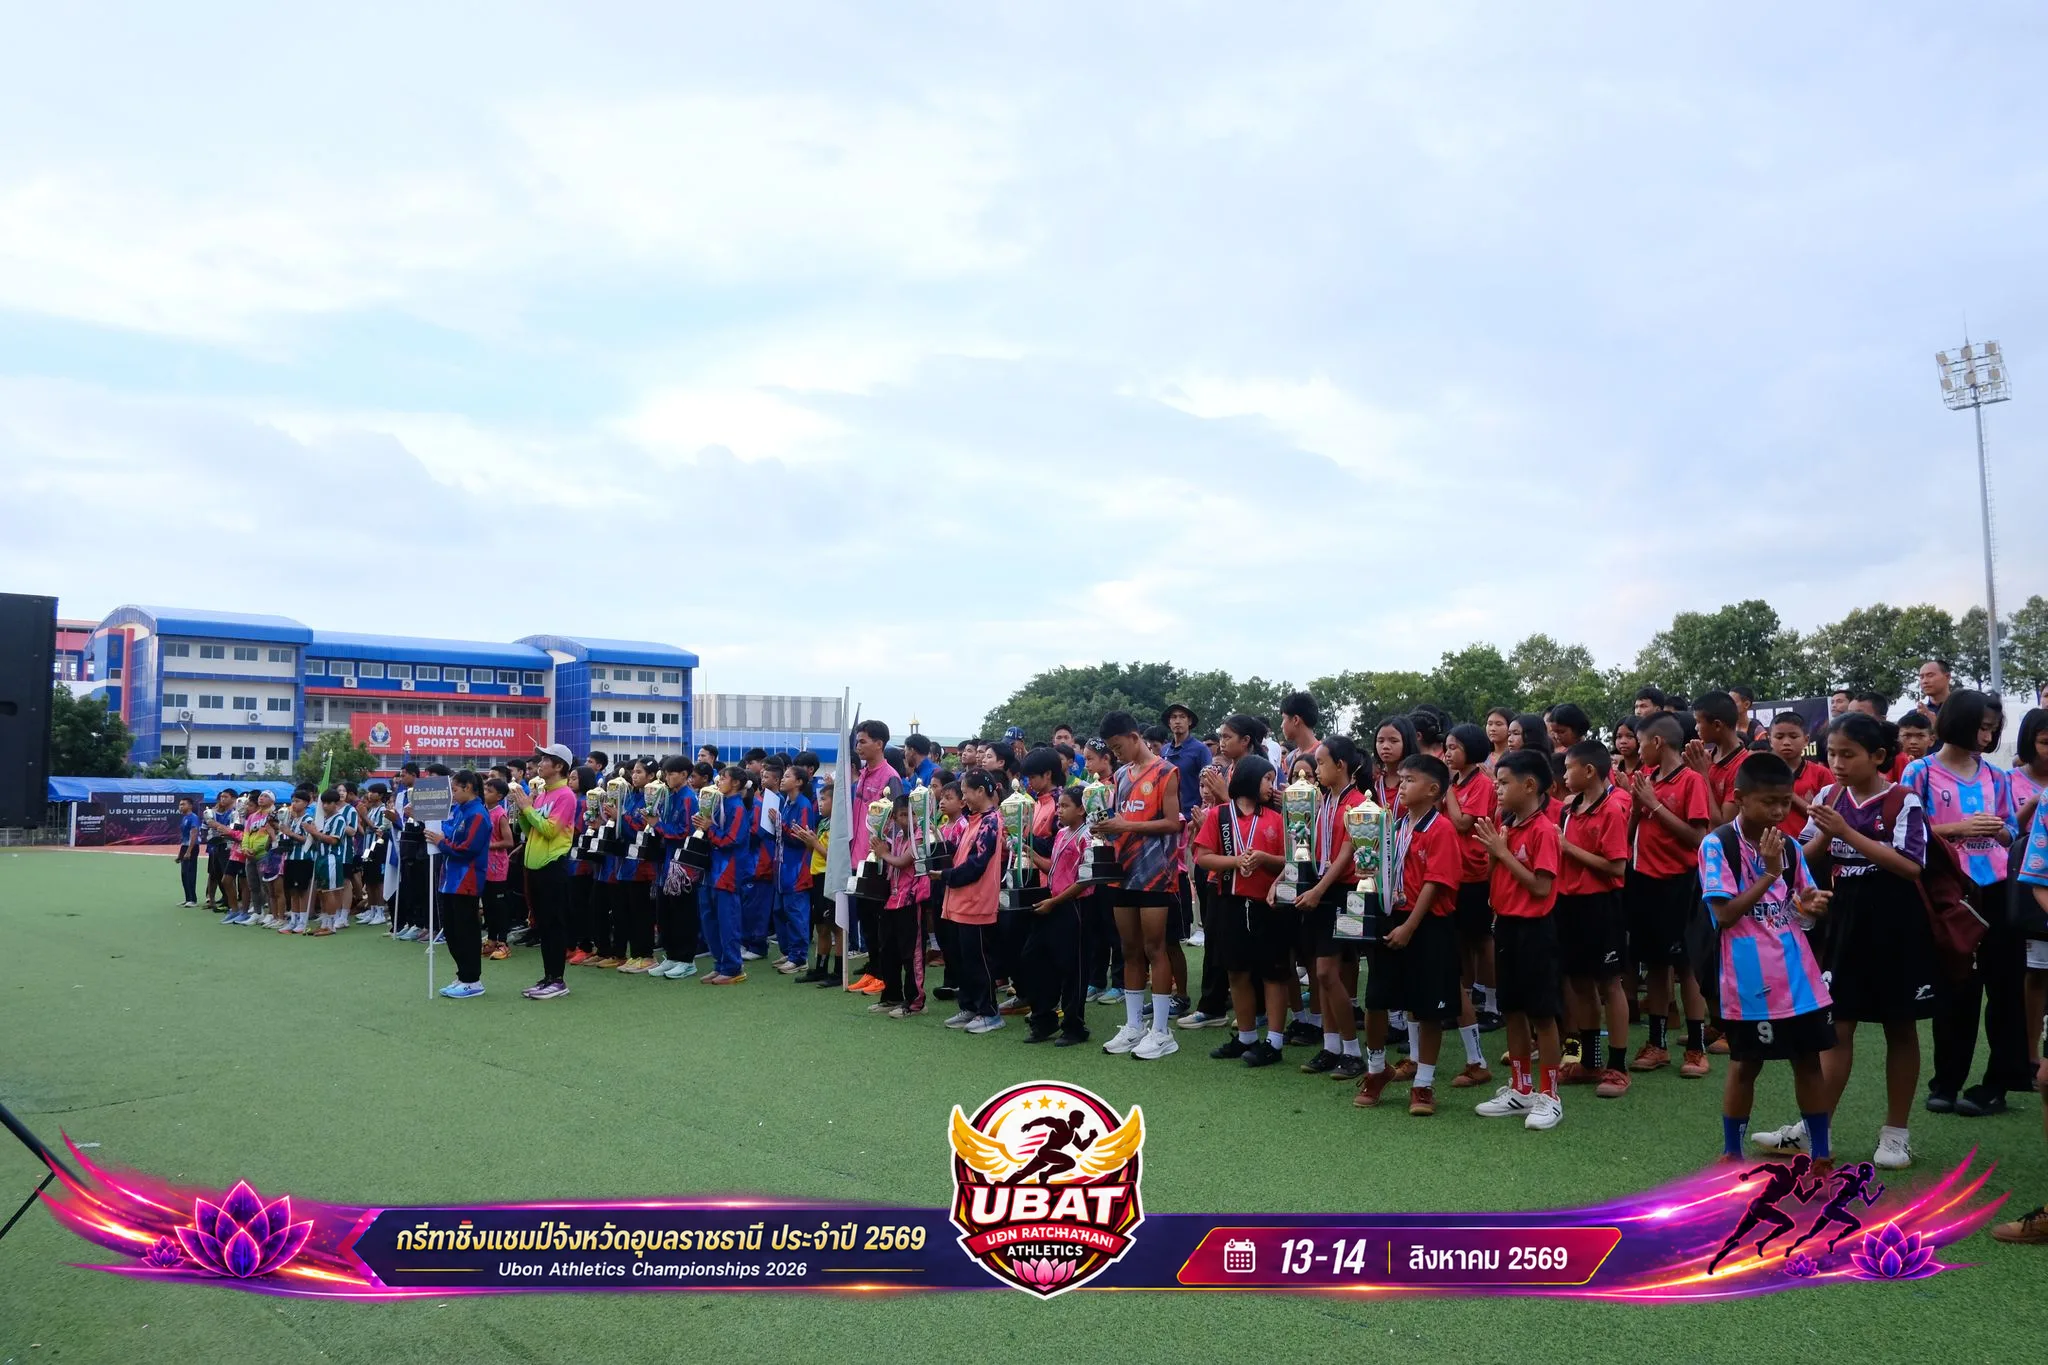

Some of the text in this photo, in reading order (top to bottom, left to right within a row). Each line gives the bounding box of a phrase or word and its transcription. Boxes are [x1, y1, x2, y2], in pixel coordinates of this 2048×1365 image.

[404, 724, 515, 737] UBONRATCHATHANI
[417, 738, 506, 749] SPORTS SCHOOL
[1941, 789, 1952, 807] 9
[1757, 1021, 1774, 1044] 9
